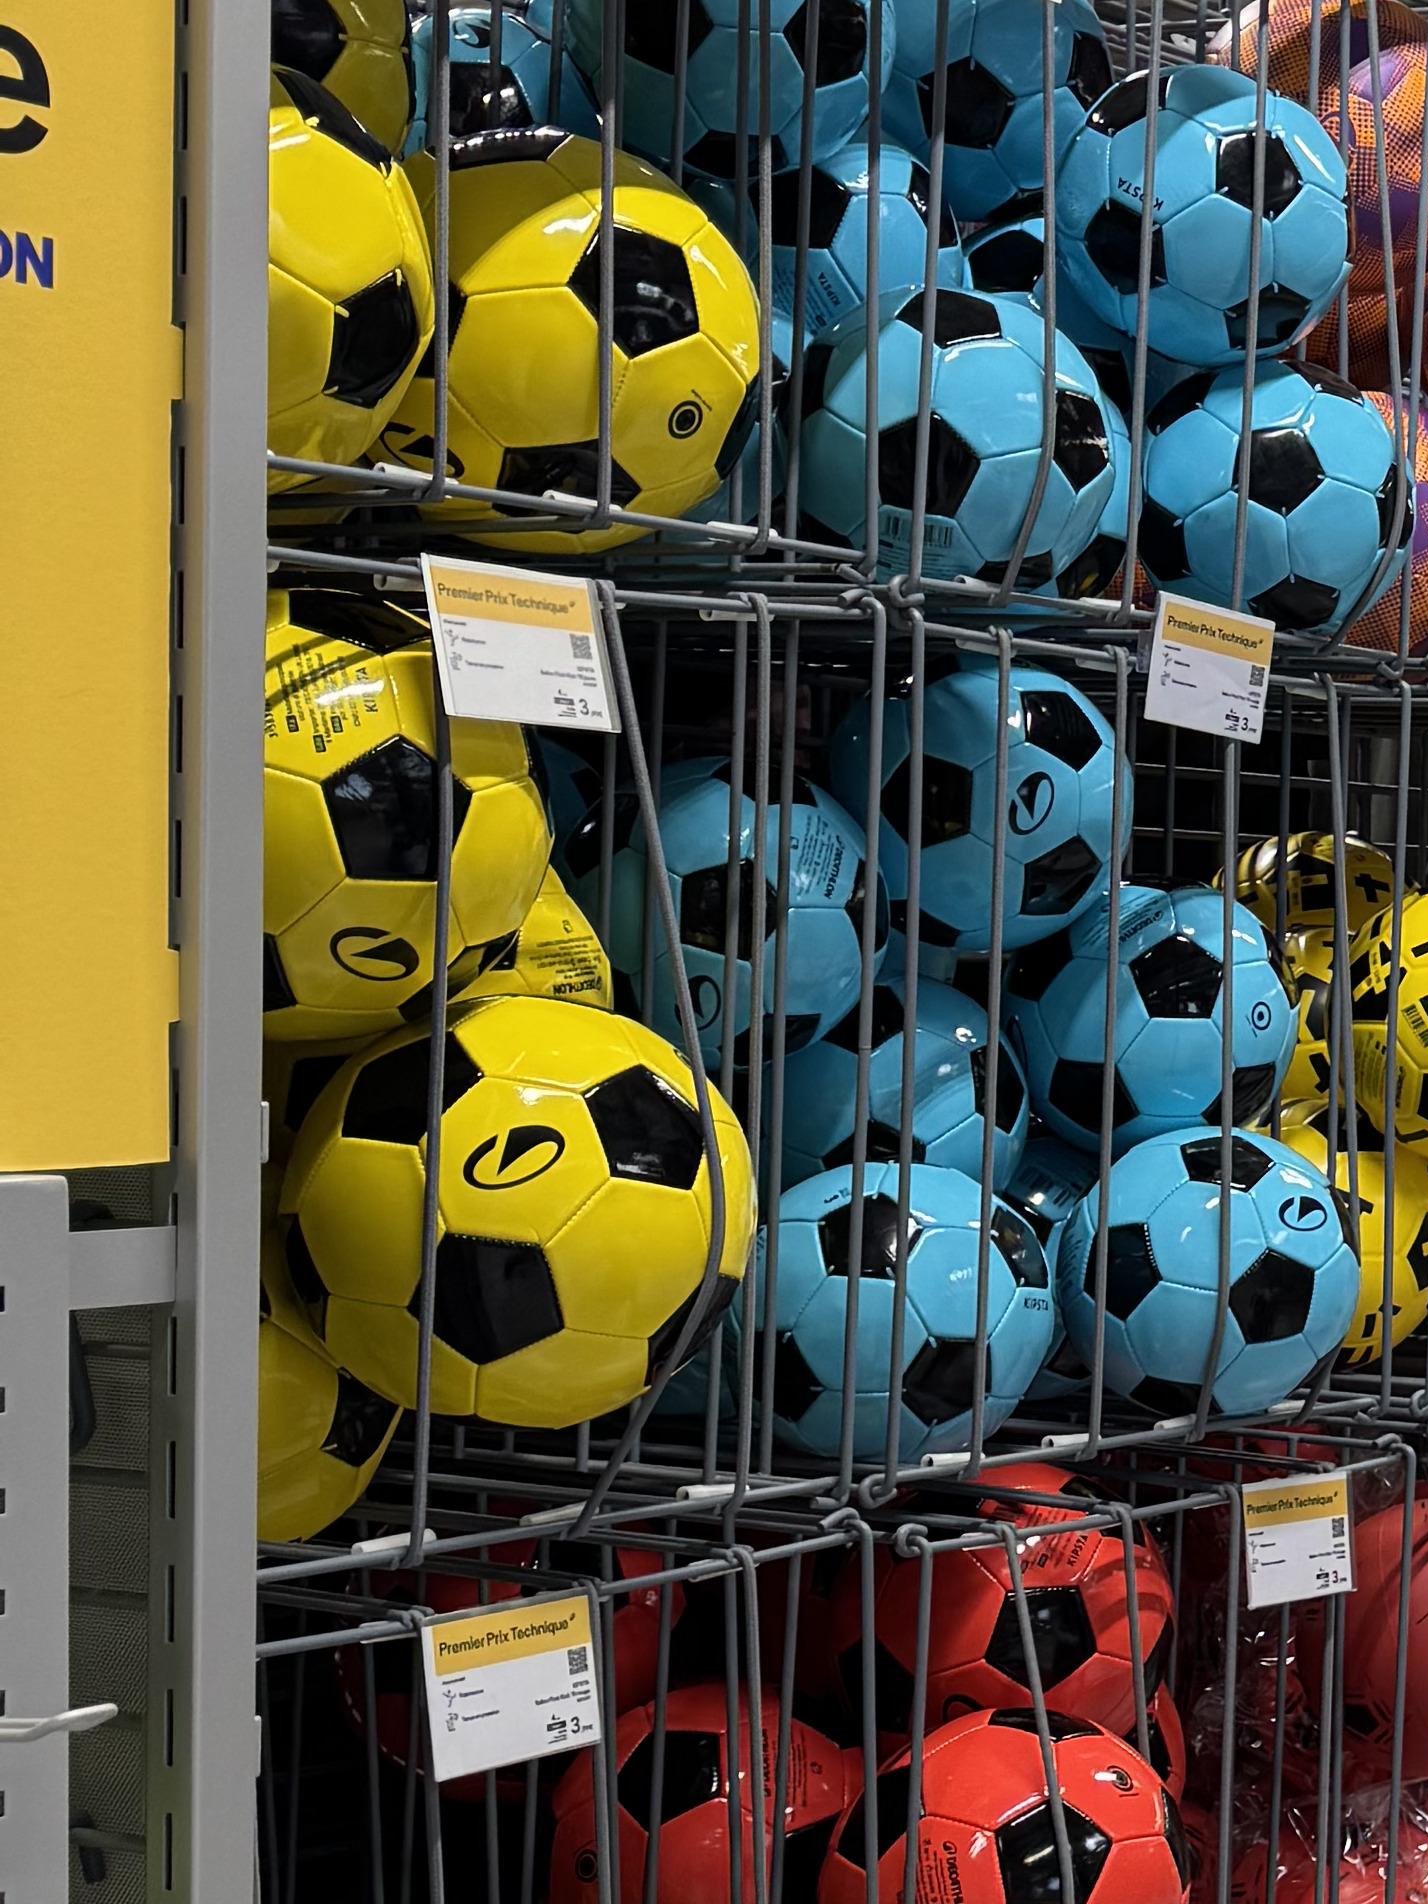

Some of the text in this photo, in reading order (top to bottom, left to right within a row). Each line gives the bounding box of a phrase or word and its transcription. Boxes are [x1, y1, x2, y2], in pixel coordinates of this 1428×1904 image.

[438, 583, 568, 614] Premier Prix Technique
[1167, 615, 1258, 649] Premier Prix Technique
[1247, 1494, 1334, 1515] Premier Prix Technique
[1066, 1535, 1088, 1567] KIPSTA
[439, 1619, 568, 1656] Premier Prix Technique
